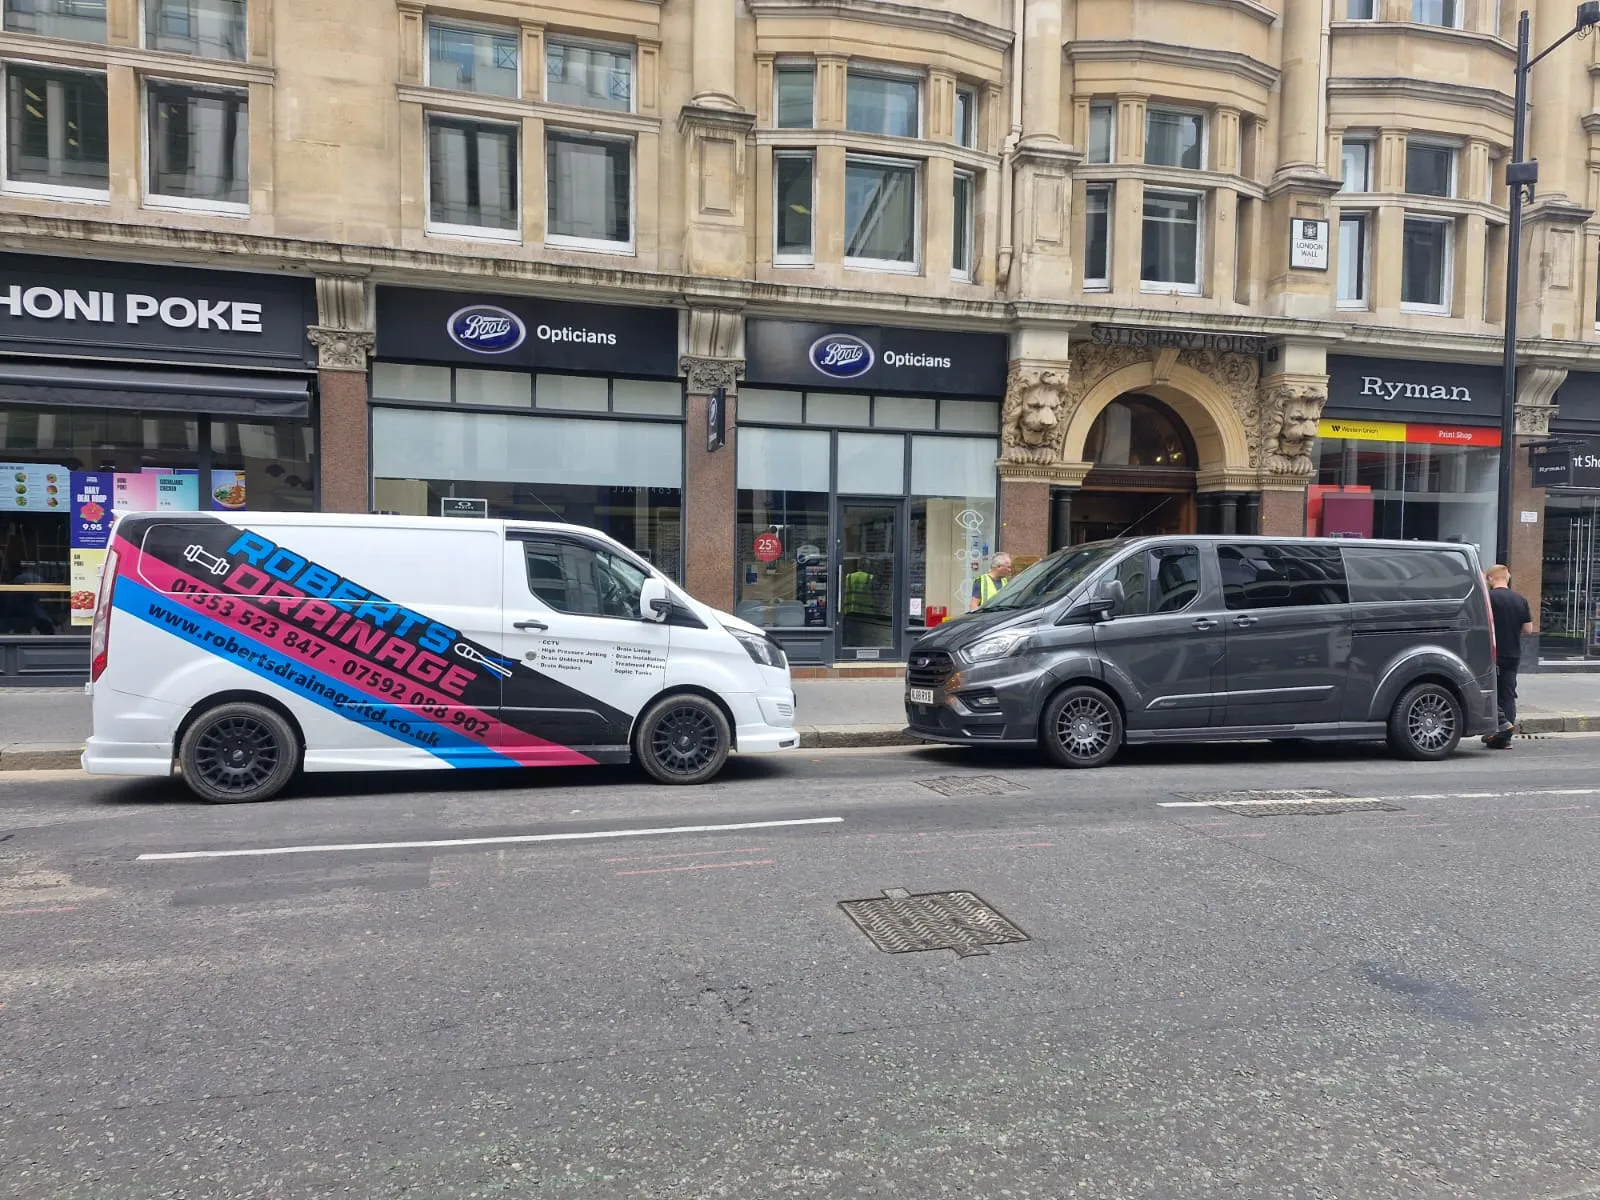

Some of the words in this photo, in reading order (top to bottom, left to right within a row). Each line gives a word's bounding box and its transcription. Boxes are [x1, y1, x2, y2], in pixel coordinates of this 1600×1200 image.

[1296, 241, 1324, 250] LONDON
[1301, 249, 1318, 258] WALL
[126, 294, 262, 333] POKE
[460, 314, 511, 340] Boots
[537, 325, 617, 345] Opticians
[1091, 327, 1197, 349] SALISBURY
[1202, 334, 1268, 354] HOUSE
[820, 342, 863, 366] Boots
[883, 351, 951, 368] Opticians
[1360, 376, 1472, 401] Ryman
[1438, 430, 1455, 438] Print
[1456, 431, 1472, 440] Shop
[1539, 465, 1566, 473] Ryman
[84, 486, 100, 495] DAILY
[82, 523, 103, 531] 9.95
[226, 530, 457, 654] ROBERTS
[223, 563, 478, 697] DRAINAGE
[171, 579, 235, 617] 01353
[238, 609, 280, 638] 523
[283, 631, 326, 659] 847
[342, 660, 407, 700] 07592
[452, 711, 490, 738] 902
[559, 656, 593, 664] Unblocking
[633, 655, 666, 663] Installation
